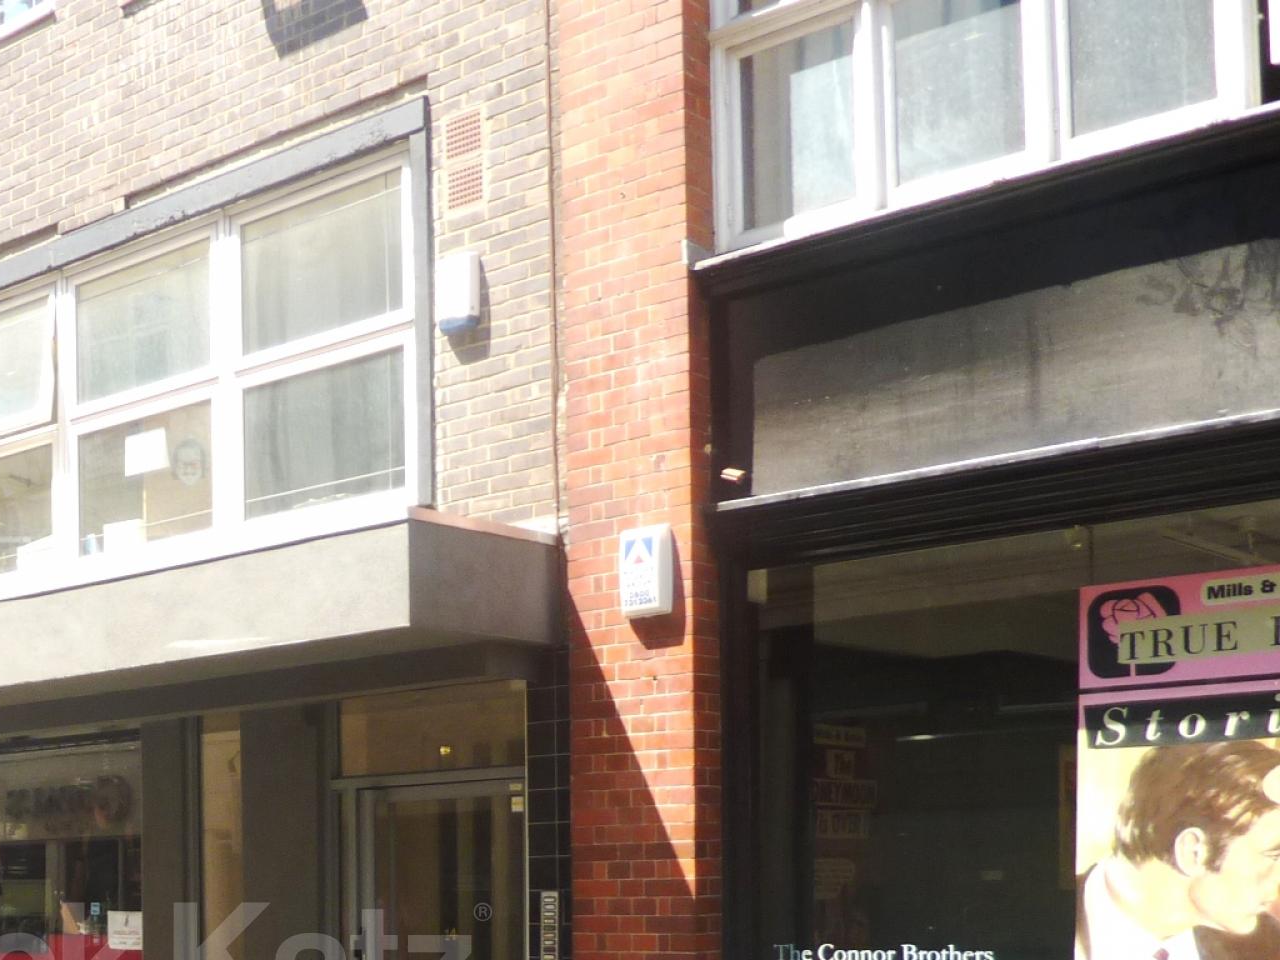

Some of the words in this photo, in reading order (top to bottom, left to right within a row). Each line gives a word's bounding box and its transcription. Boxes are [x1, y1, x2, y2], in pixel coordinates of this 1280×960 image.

[1207, 582, 1254, 600] Mills
[1261, 579, 1277, 594] &
[1120, 621, 1239, 661] TRUE
